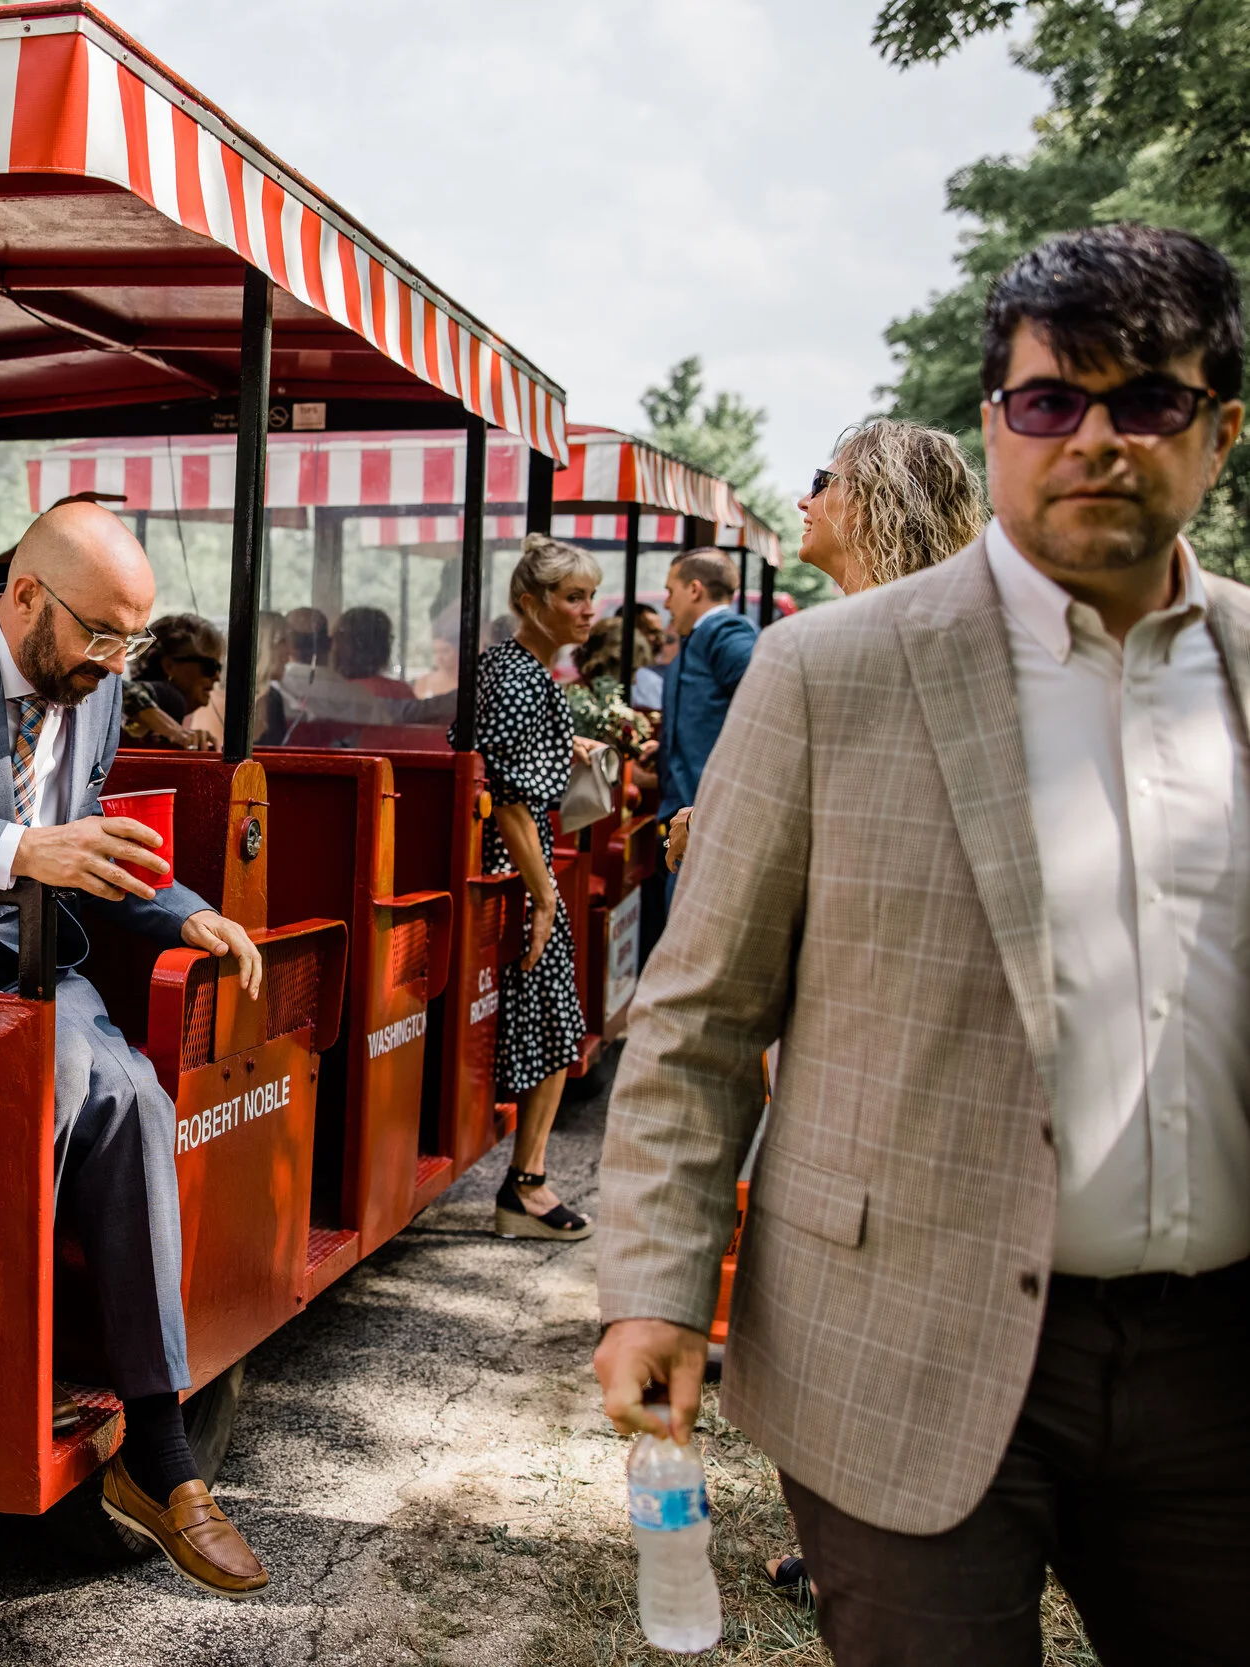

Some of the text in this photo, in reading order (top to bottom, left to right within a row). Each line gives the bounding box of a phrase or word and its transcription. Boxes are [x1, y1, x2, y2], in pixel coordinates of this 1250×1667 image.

[367, 1010, 427, 1059] WASHINGTON
[177, 1075, 290, 1155] ROBERT NOBLE
